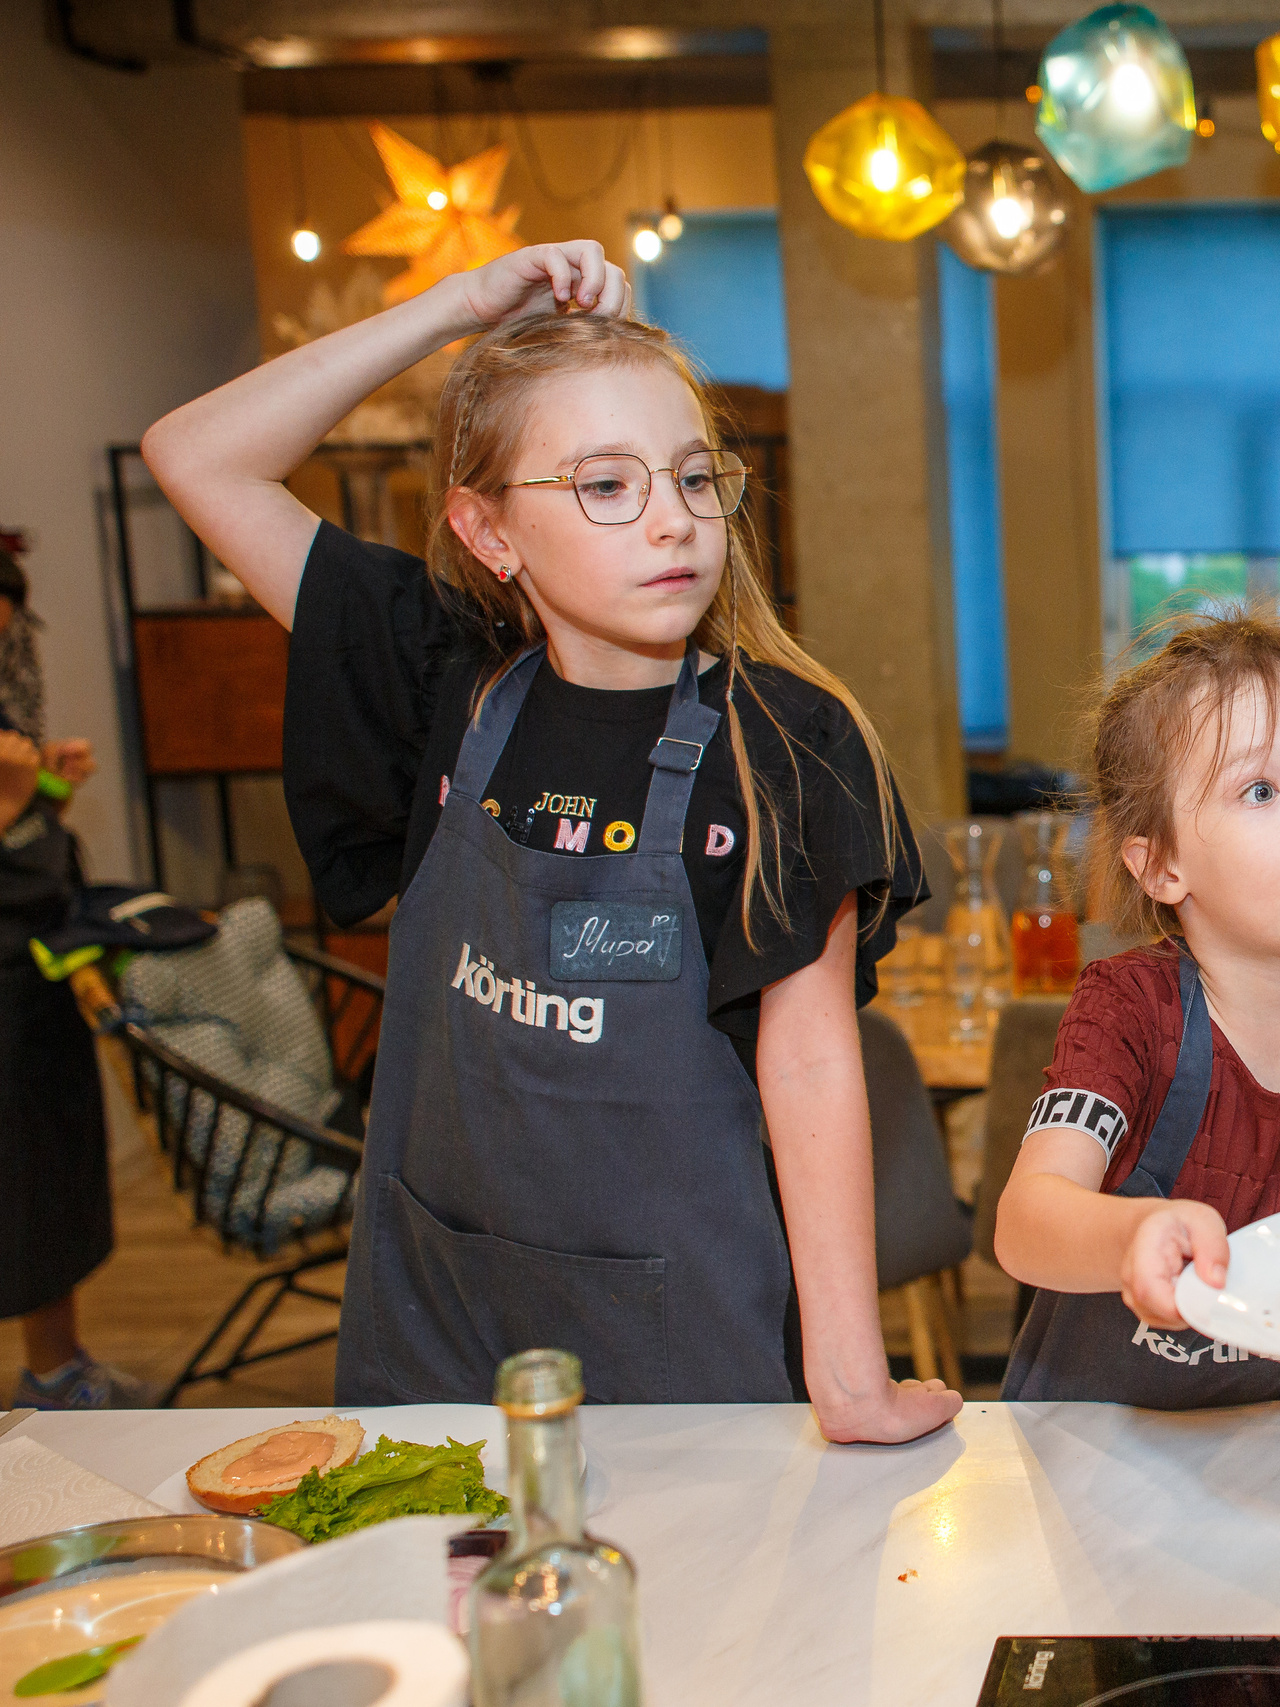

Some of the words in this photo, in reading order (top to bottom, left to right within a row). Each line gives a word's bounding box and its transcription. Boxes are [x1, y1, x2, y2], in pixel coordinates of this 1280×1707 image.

[533, 791, 597, 818] JOHN
[563, 915, 655, 966] Мира
[451, 942, 604, 1044] körting
